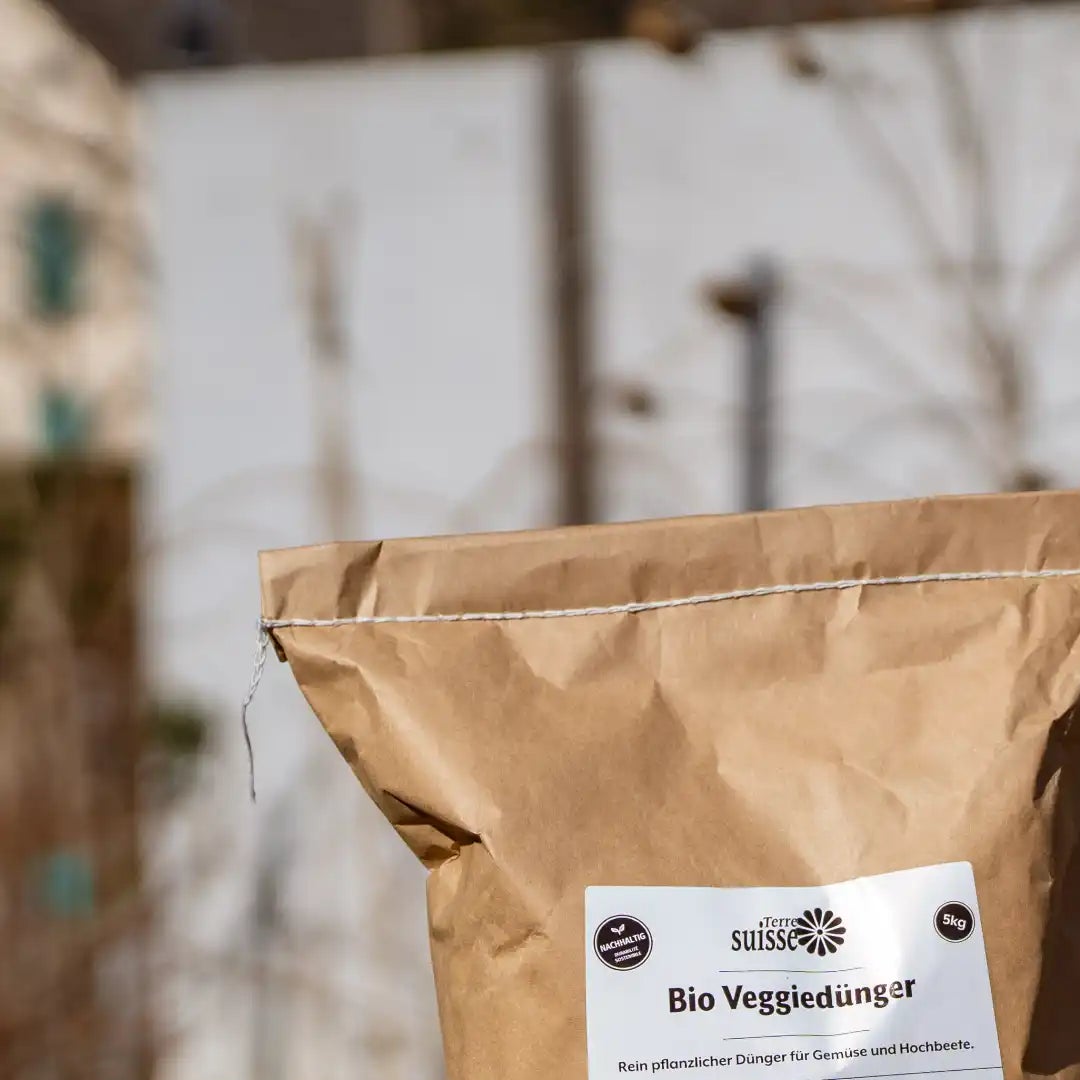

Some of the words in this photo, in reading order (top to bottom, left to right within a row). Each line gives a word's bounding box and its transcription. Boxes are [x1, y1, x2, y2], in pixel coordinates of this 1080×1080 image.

[763, 916, 799, 928] Terre
[942, 914, 967, 931] 5kg
[599, 932, 646, 953] NACHHALTIG
[731, 920, 799, 952] suisse
[668, 986, 715, 1013] Bio
[721, 978, 916, 1016] Veggiedünger
[618, 1060, 648, 1073] Rein
[651, 1056, 733, 1074] pflanzlicher
[735, 1053, 787, 1066] Dünger
[790, 1050, 810, 1061] für
[812, 1048, 868, 1061] Gemüse
[871, 1044, 897, 1056] und
[899, 1039, 975, 1055] Hochbeete.
